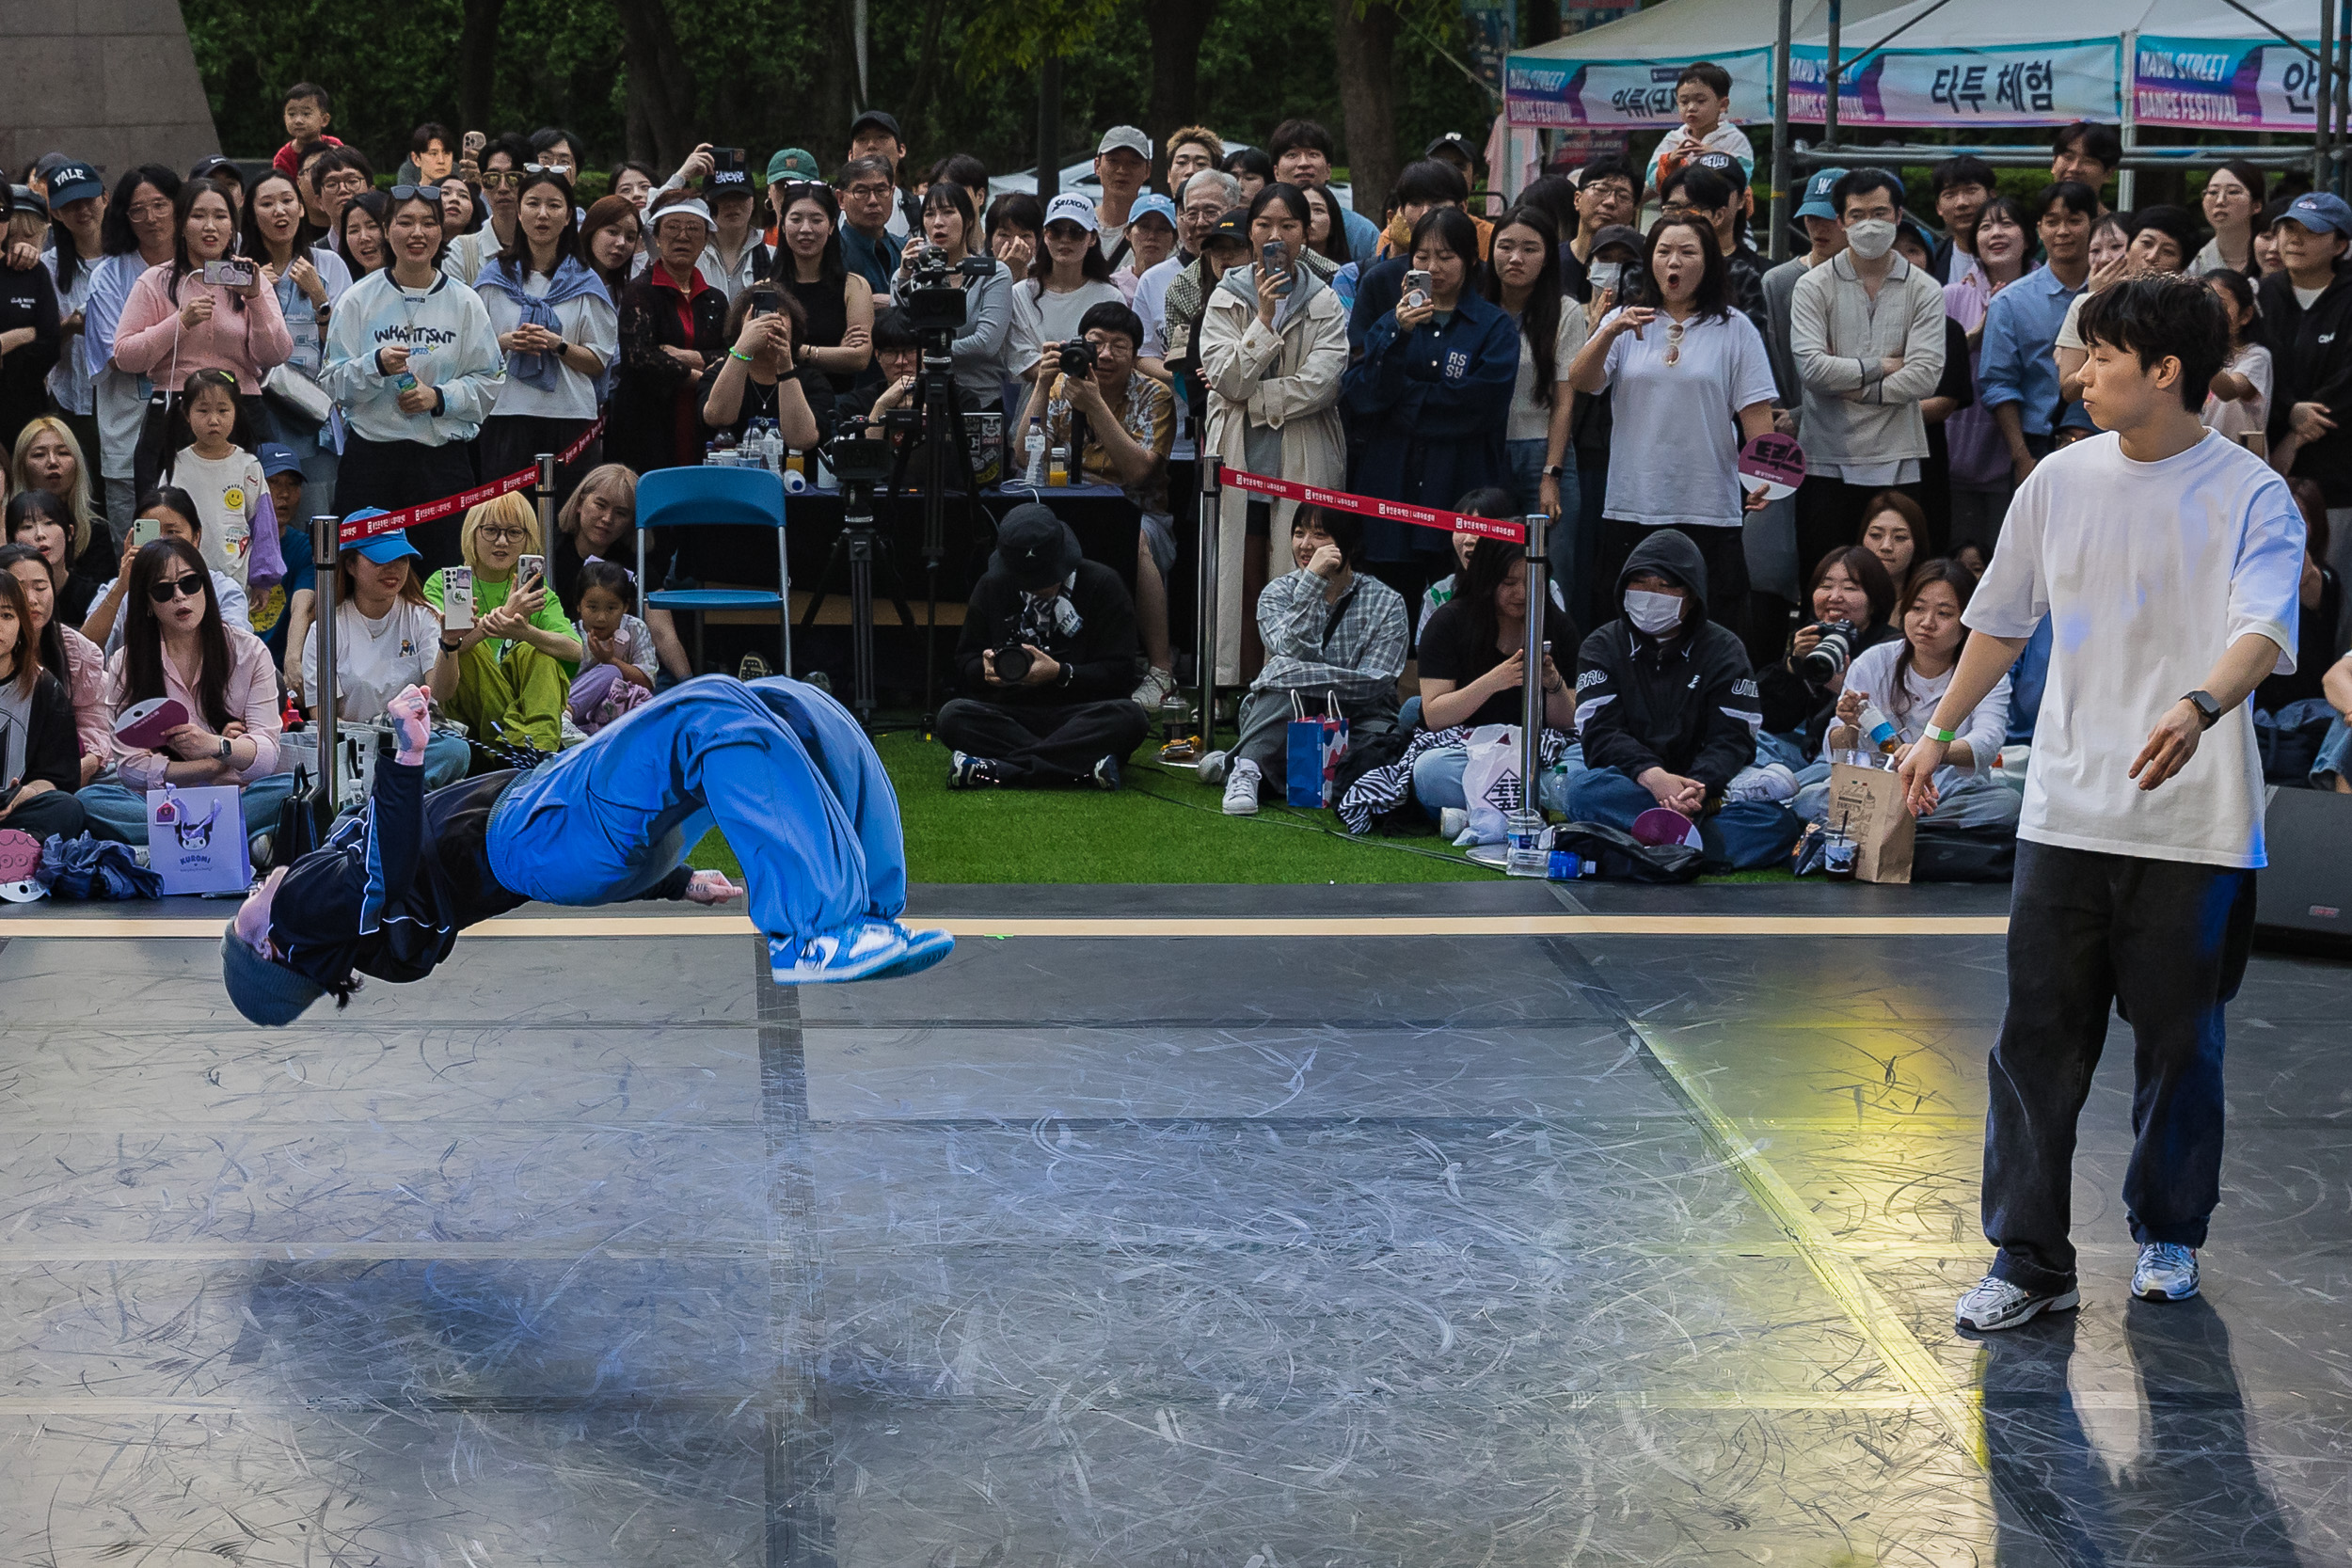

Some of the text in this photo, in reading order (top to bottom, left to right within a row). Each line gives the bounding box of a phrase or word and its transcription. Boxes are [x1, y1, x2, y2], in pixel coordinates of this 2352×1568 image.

[2175, 53, 2230, 82] STREET
[1931, 59, 2055, 113] 타투 체험
[2139, 91, 2239, 122] DANCE FESTIVAL
[54, 168, 86, 187] YALE
[1052, 198, 1089, 213] SRIXON
[1449, 352, 1467, 366] RS
[1748, 440, 1804, 474] 트릭스
[1576, 669, 1608, 693] BRO
[180, 855, 211, 865] KUROMI
